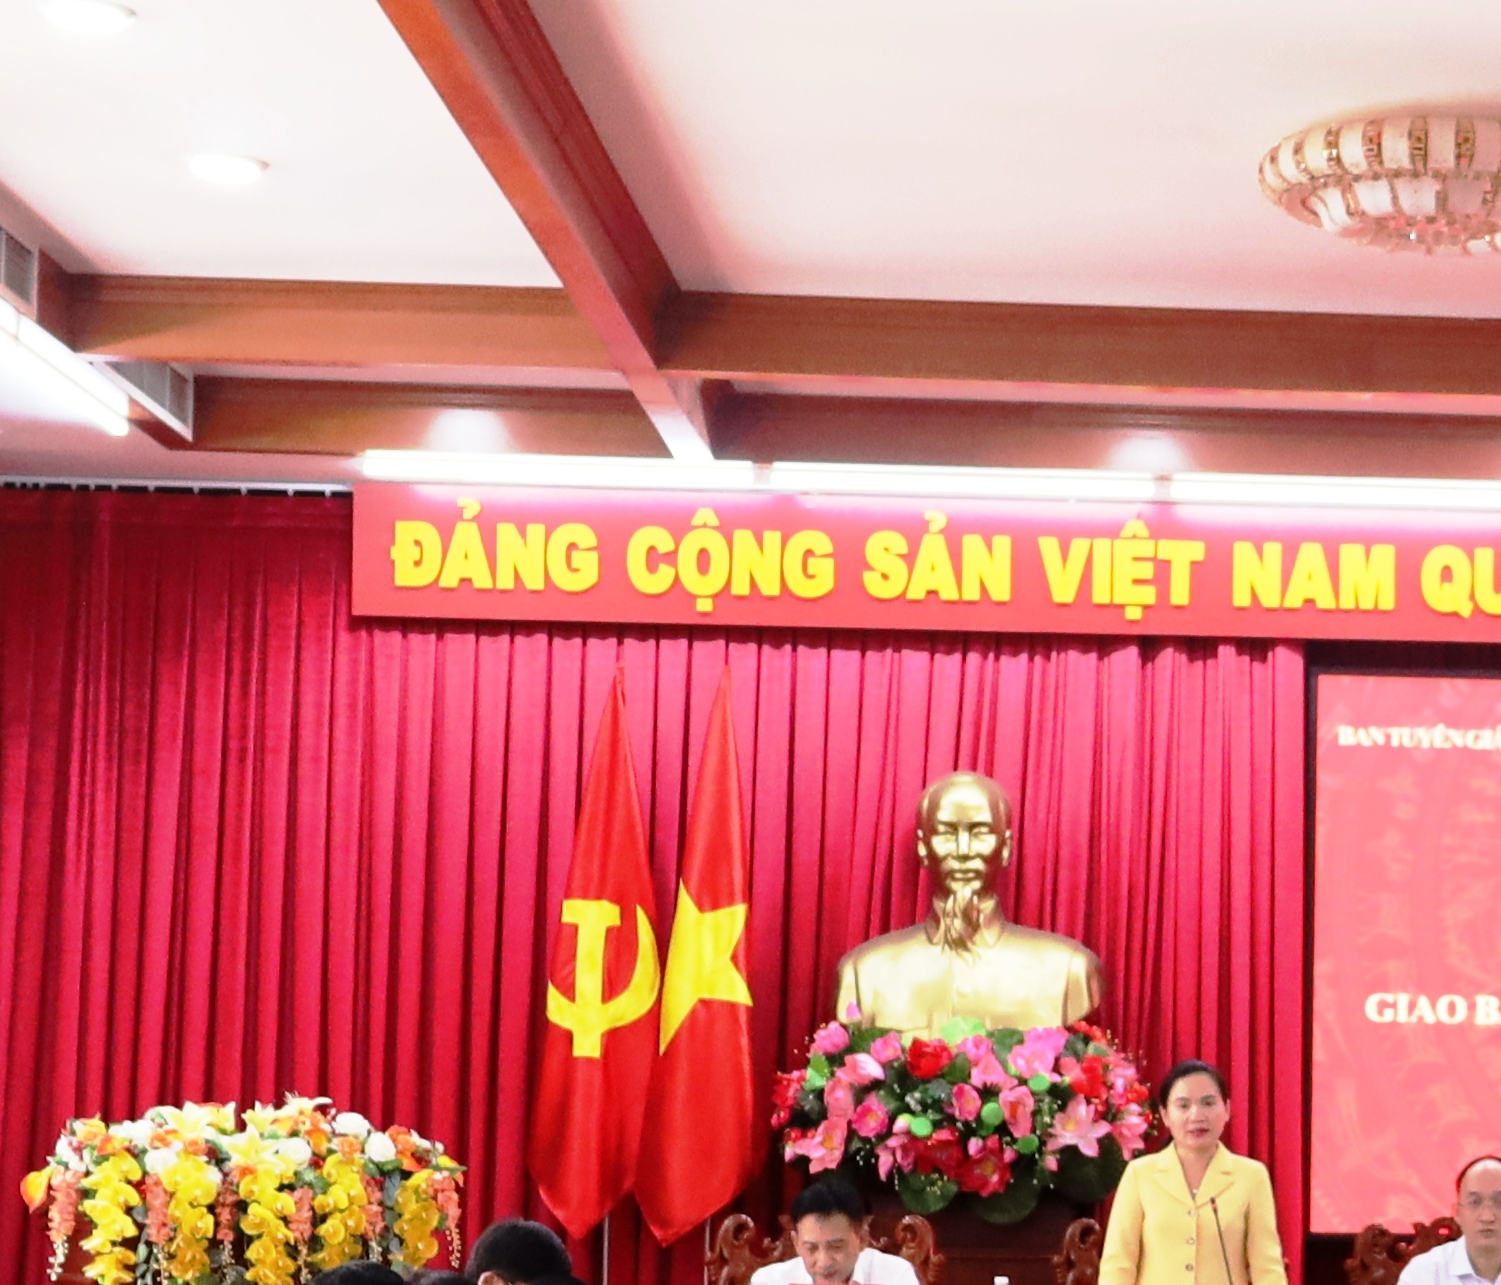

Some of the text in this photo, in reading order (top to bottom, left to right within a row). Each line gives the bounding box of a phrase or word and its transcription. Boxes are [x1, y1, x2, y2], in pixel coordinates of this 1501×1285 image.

[390, 498, 599, 594] ĐẢNG
[627, 508, 835, 613] CỘNG
[862, 510, 1012, 603] SẢN
[1039, 519, 1205, 621] VIỆT
[1233, 541, 1395, 611] NAM
[1337, 725, 1386, 747] BAN
[1386, 723, 1466, 748] TUYÊN
[1364, 992, 1468, 1025] GIAO
